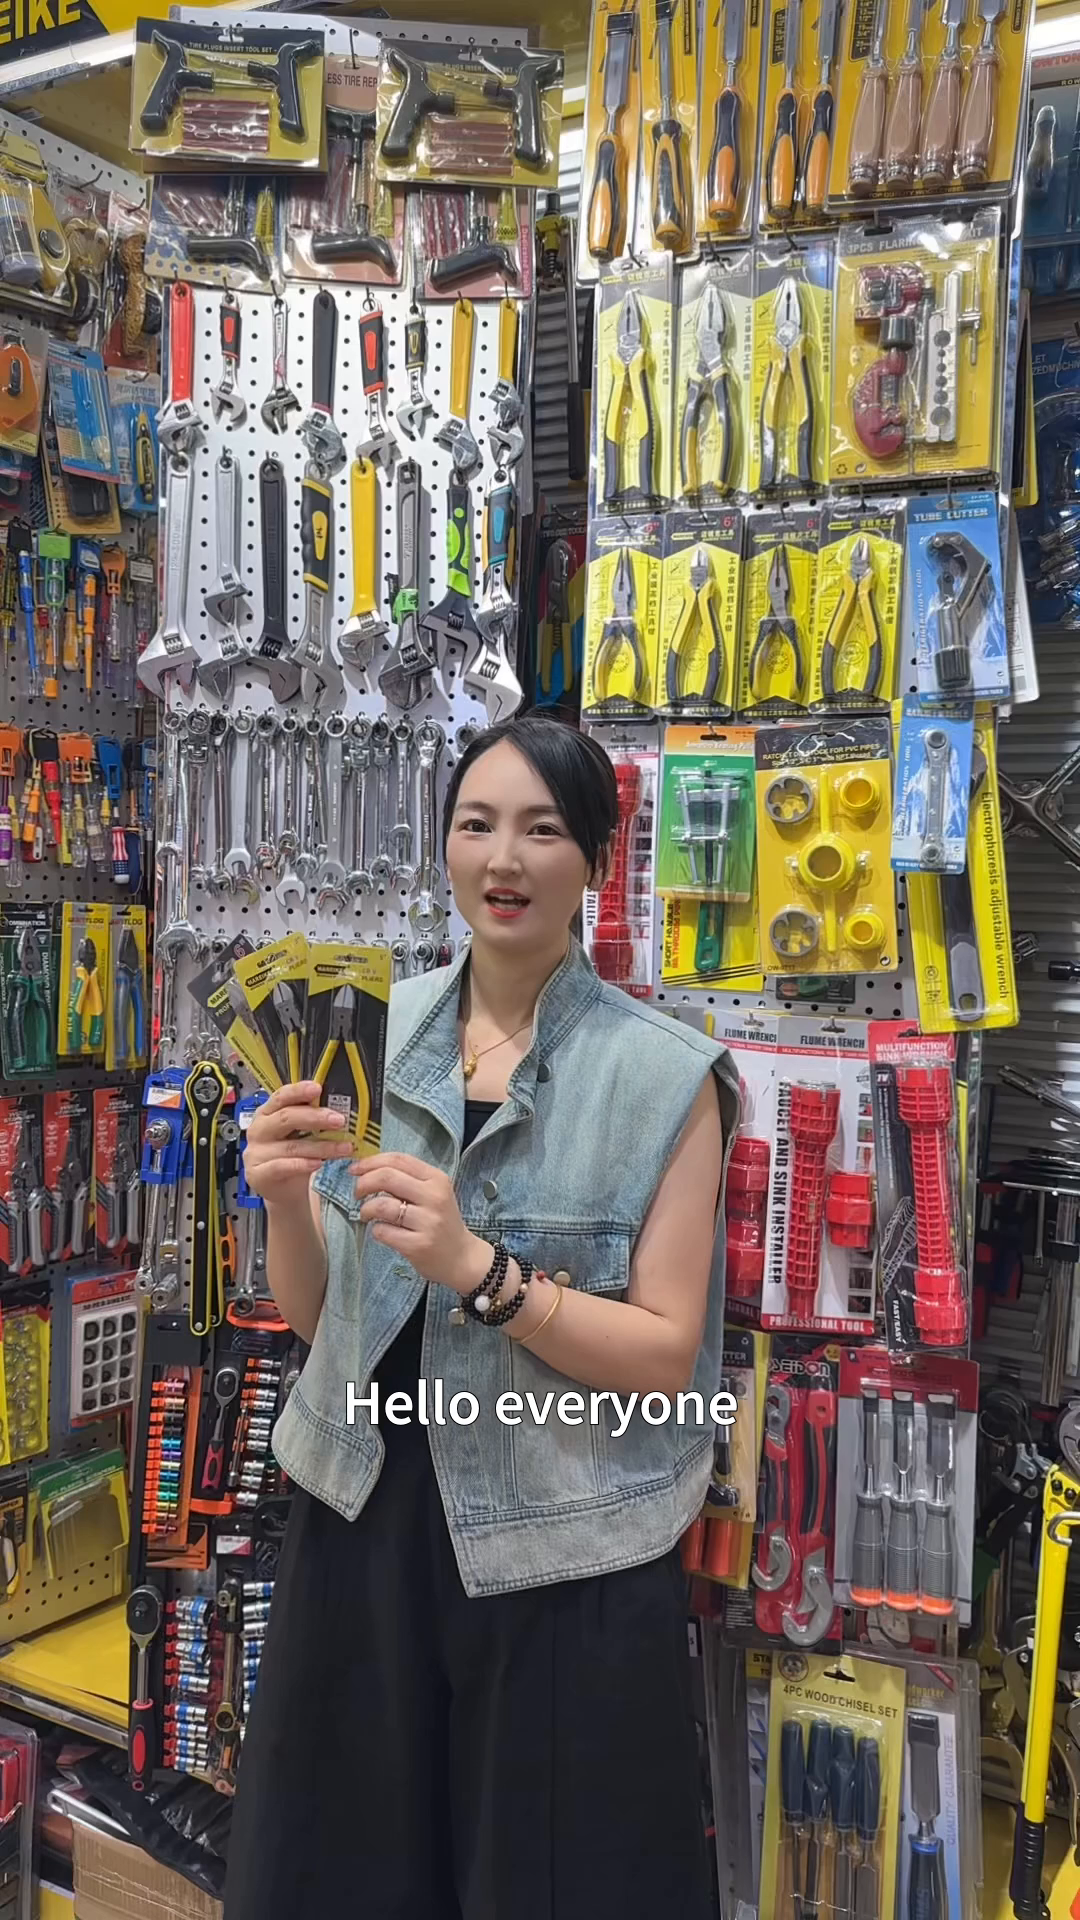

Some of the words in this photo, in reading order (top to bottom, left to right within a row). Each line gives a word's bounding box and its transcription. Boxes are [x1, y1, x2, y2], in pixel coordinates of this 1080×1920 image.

[344, 74, 361, 86] TIRE
[913, 511, 942, 522] TUBE
[830, 746, 844, 755] FOR
[845, 745, 859, 753] PVC
[860, 743, 880, 751] PIPES
[981, 791, 999, 886] Electrophoresis
[988, 888, 1004, 951] adjustable
[995, 953, 1010, 999] wrench
[724, 1027, 747, 1041] FLUME
[800, 1035, 827, 1047] FLUME
[875, 1041, 946, 1053] MULTIFUNCTION
[776, 1081, 792, 1132] FAUCET
[775, 1139, 789, 1167] AND
[773, 1170, 787, 1206] SINK
[768, 1211, 786, 1284] INSTALLER
[769, 1316, 838, 1330] PROFESSIONAL
[842, 1321, 865, 1332] TOOL
[783, 1684, 803, 1698] 4PC
[804, 1687, 836, 1705] WOOD
[838, 1696, 876, 1714] CHISEL
[878, 1706, 898, 1719] SET
